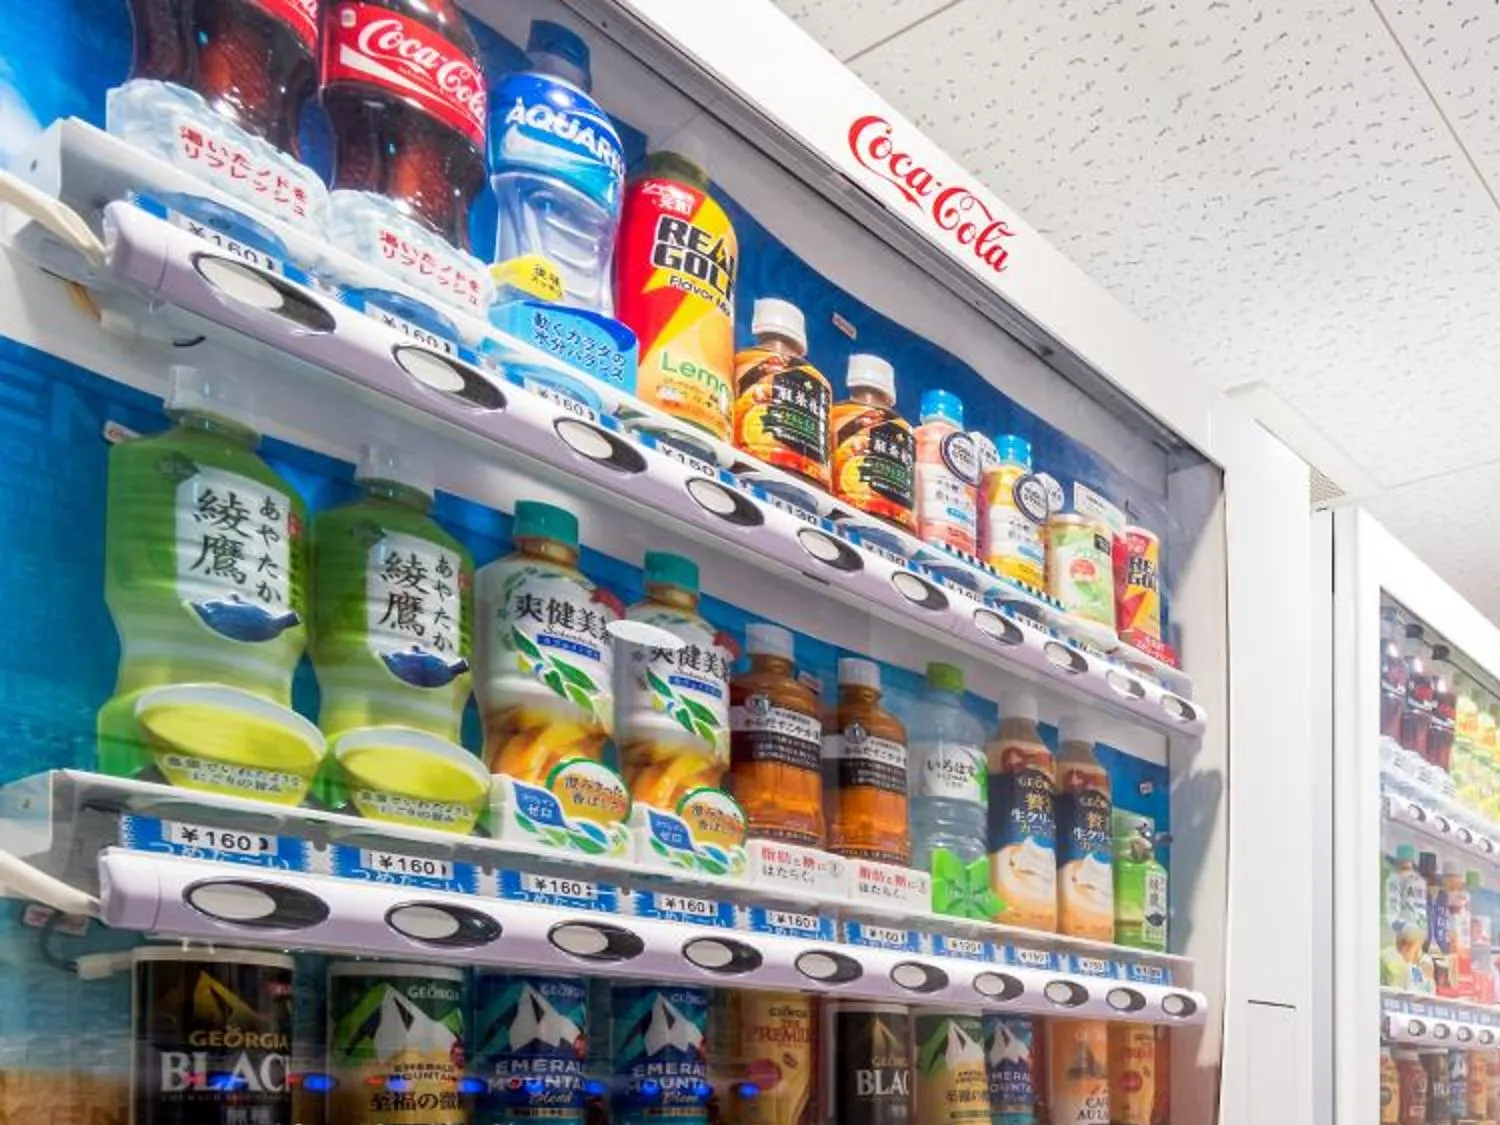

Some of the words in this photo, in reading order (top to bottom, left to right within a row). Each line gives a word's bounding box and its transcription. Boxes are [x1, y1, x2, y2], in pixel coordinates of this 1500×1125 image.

[358, 18, 487, 124] Coca-Cola
[504, 96, 624, 174] AQUAR
[848, 115, 1016, 273] Coca-Cola
[188, 488, 253, 586] 綾鷹
[255, 494, 283, 603] あやたか
[377, 549, 433, 637] 綾鷹
[433, 552, 456, 652] あやたか
[181, 826, 252, 852] ¥160
[378, 854, 436, 876] ¥160
[534, 876, 582, 898] ¥160
[664, 896, 707, 914] ¥160
